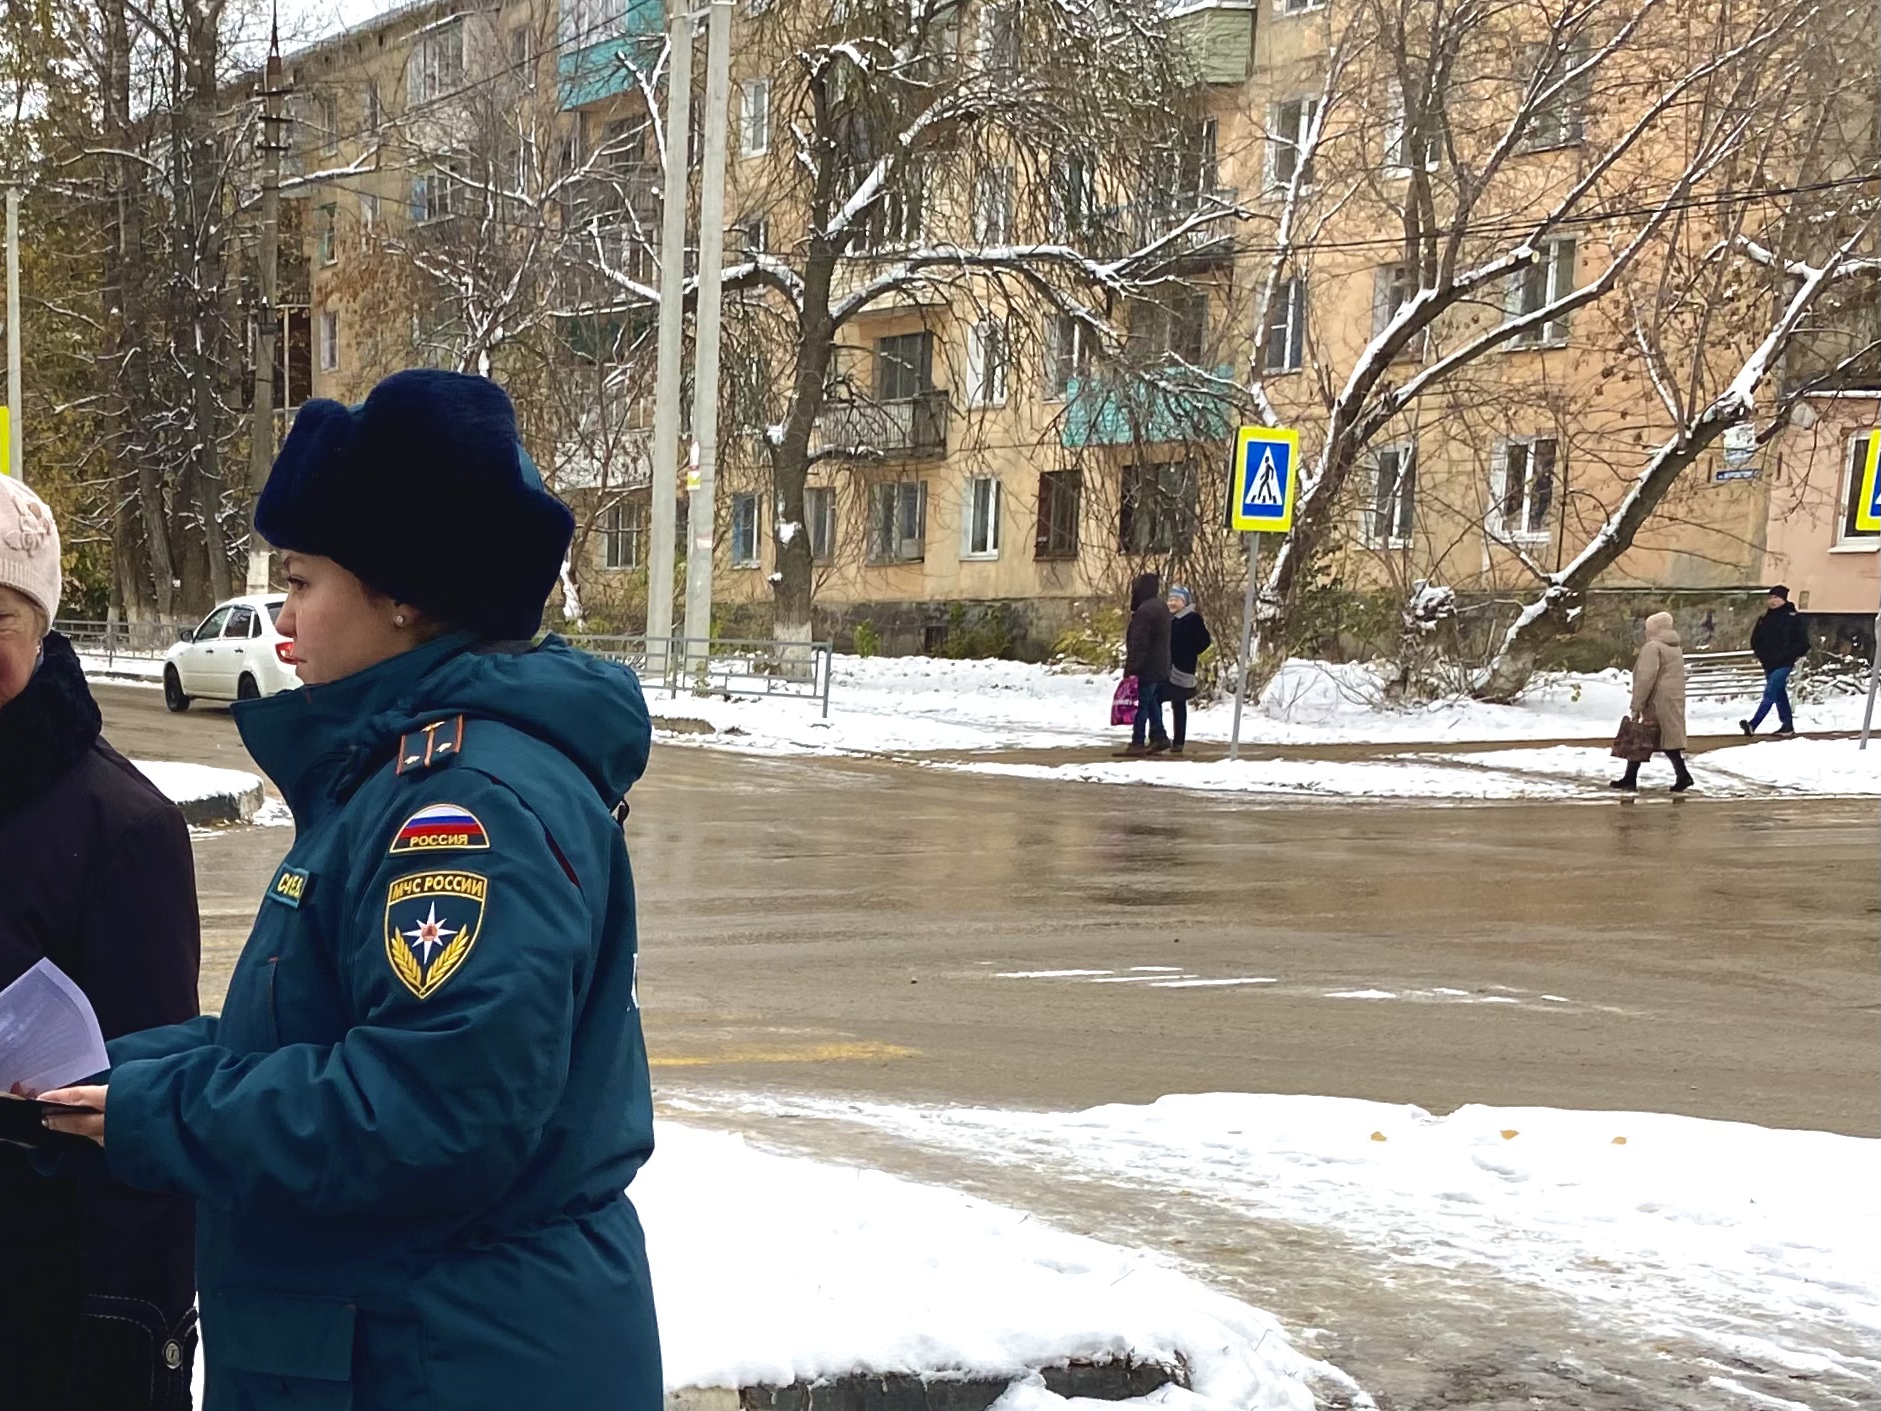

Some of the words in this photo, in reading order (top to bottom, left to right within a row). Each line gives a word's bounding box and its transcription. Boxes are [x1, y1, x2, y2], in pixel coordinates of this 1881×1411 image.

[410, 834, 468, 847] РОССИЯ
[392, 879, 422, 900] МЧС
[424, 875, 483, 896] РОССИИ
